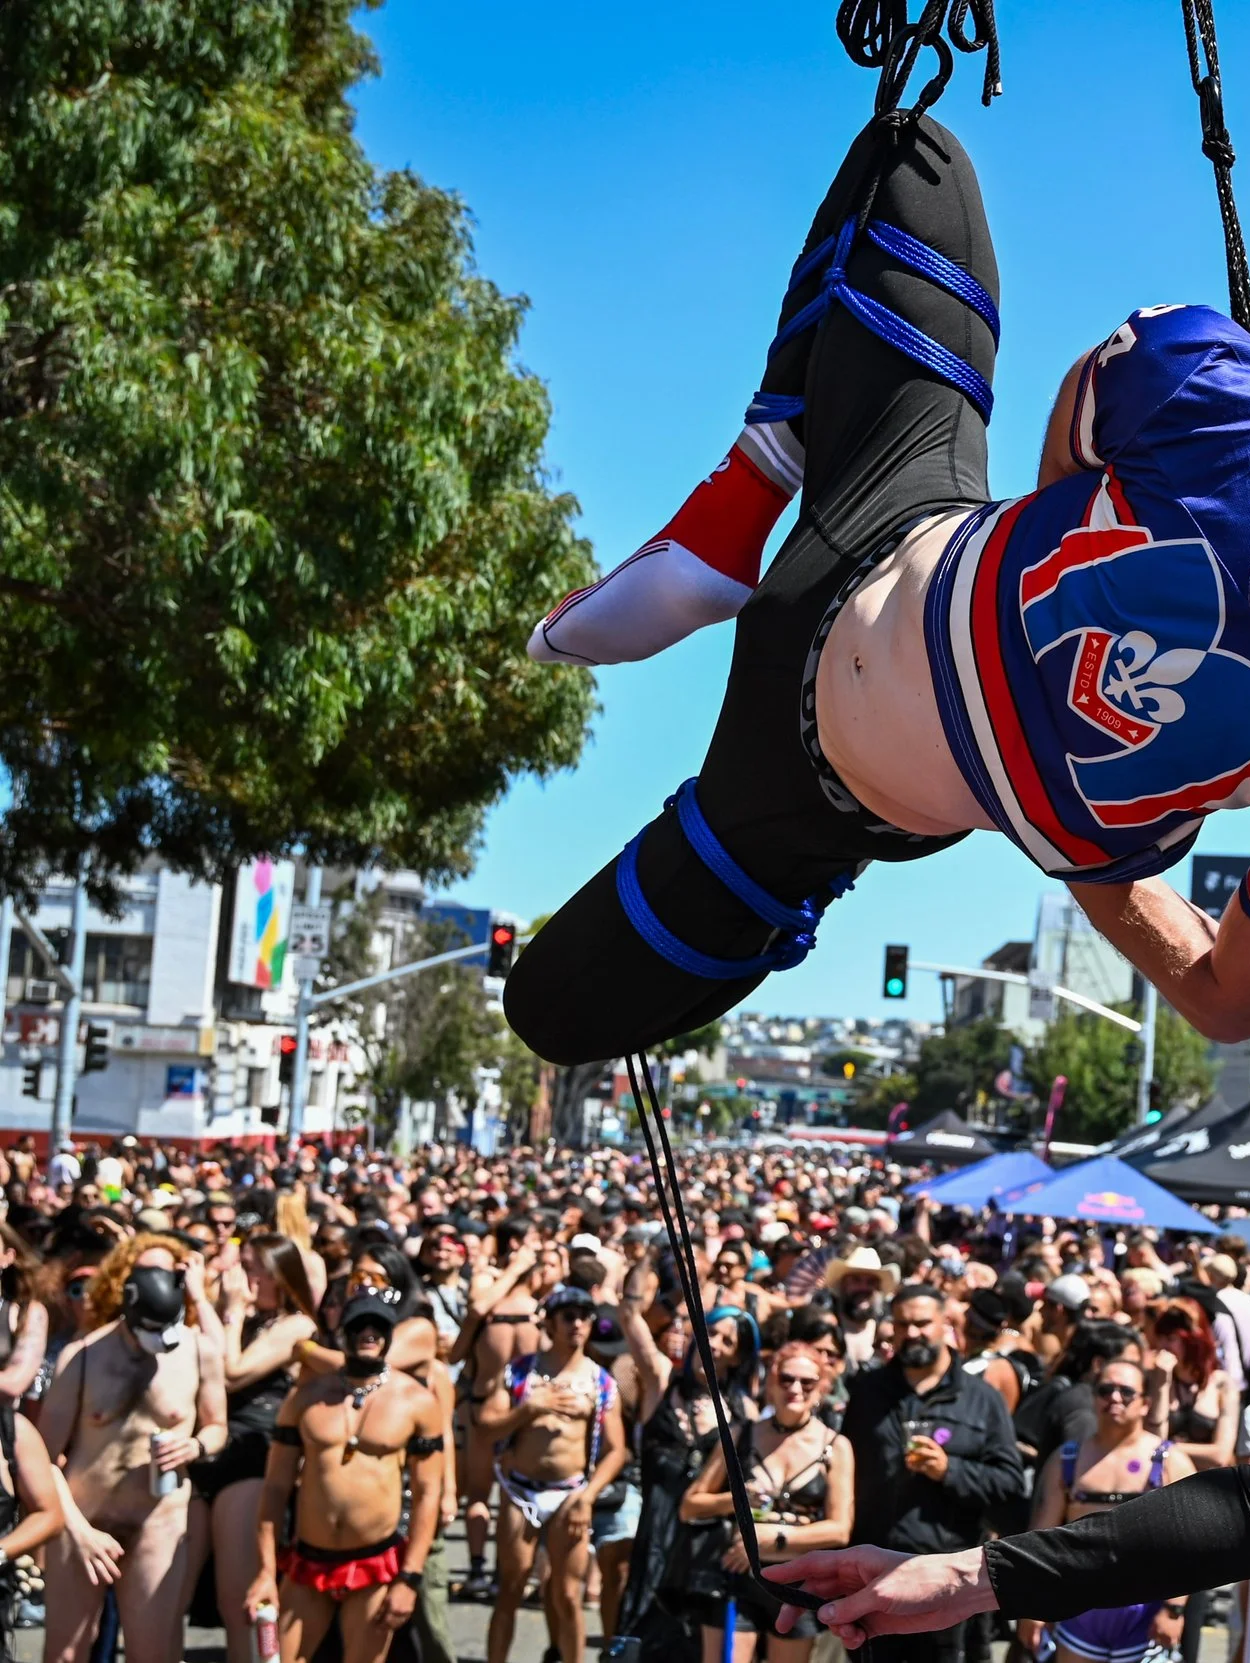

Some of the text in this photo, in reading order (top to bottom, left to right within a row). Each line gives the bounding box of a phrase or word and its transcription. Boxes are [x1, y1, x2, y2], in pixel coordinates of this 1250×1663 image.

[1080, 651, 1097, 689] ESTD
[1096, 707, 1122, 729] 1909
[292, 933, 325, 953] 25
